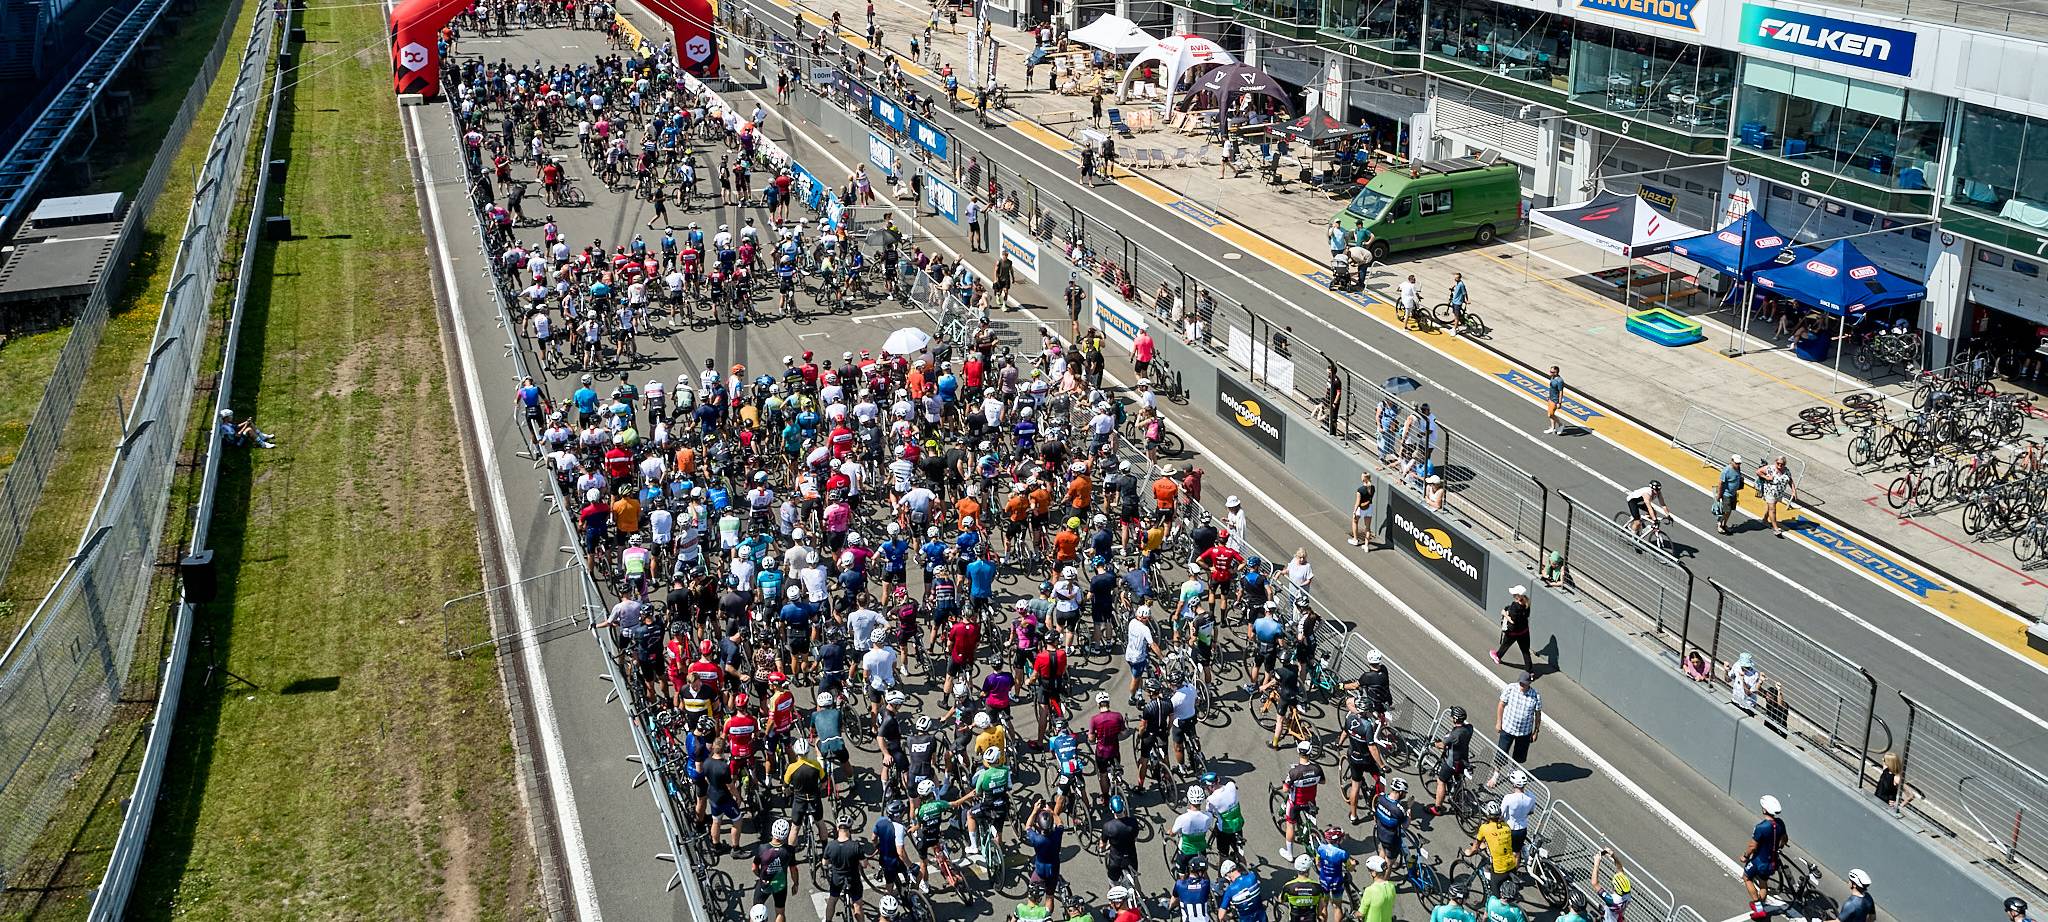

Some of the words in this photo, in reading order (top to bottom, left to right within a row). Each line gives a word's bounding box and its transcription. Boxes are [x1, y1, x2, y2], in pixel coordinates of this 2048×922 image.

[1587, 0, 1684, 20] AVENOL
[1259, 19, 1267, 30] 11
[1759, 18, 1891, 61] FALKEN
[1348, 44, 1357, 56] 10
[1621, 120, 1629, 134] 9
[1800, 170, 1810, 186] 8
[1641, 188, 1674, 206] HAZET
[2036, 237, 2048, 255] 7
[1221, 391, 1279, 440] motorsport.com
[1395, 512, 1478, 580] motorsport.com
